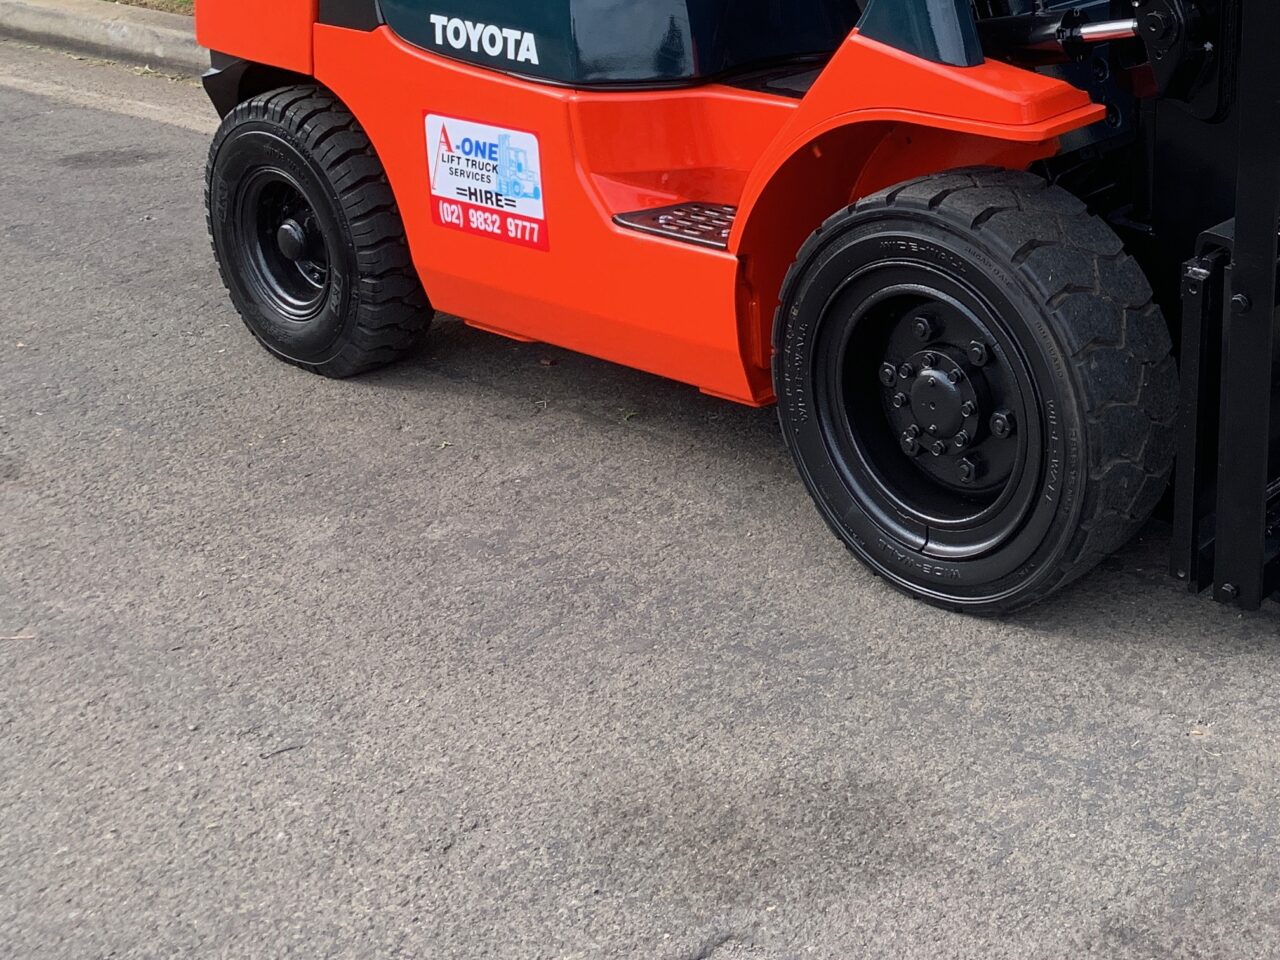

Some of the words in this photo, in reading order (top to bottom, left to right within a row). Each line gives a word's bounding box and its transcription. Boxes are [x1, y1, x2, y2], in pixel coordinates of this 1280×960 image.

[429, 13, 540, 66] TOYOTA
[441, 153, 462, 167] LIFT
[465, 158, 499, 175] TRUCK
[448, 167, 492, 184] SERVICES
[438, 200, 464, 228] (02)
[468, 208, 502, 234] 9832
[506, 217, 540, 243] 9777
